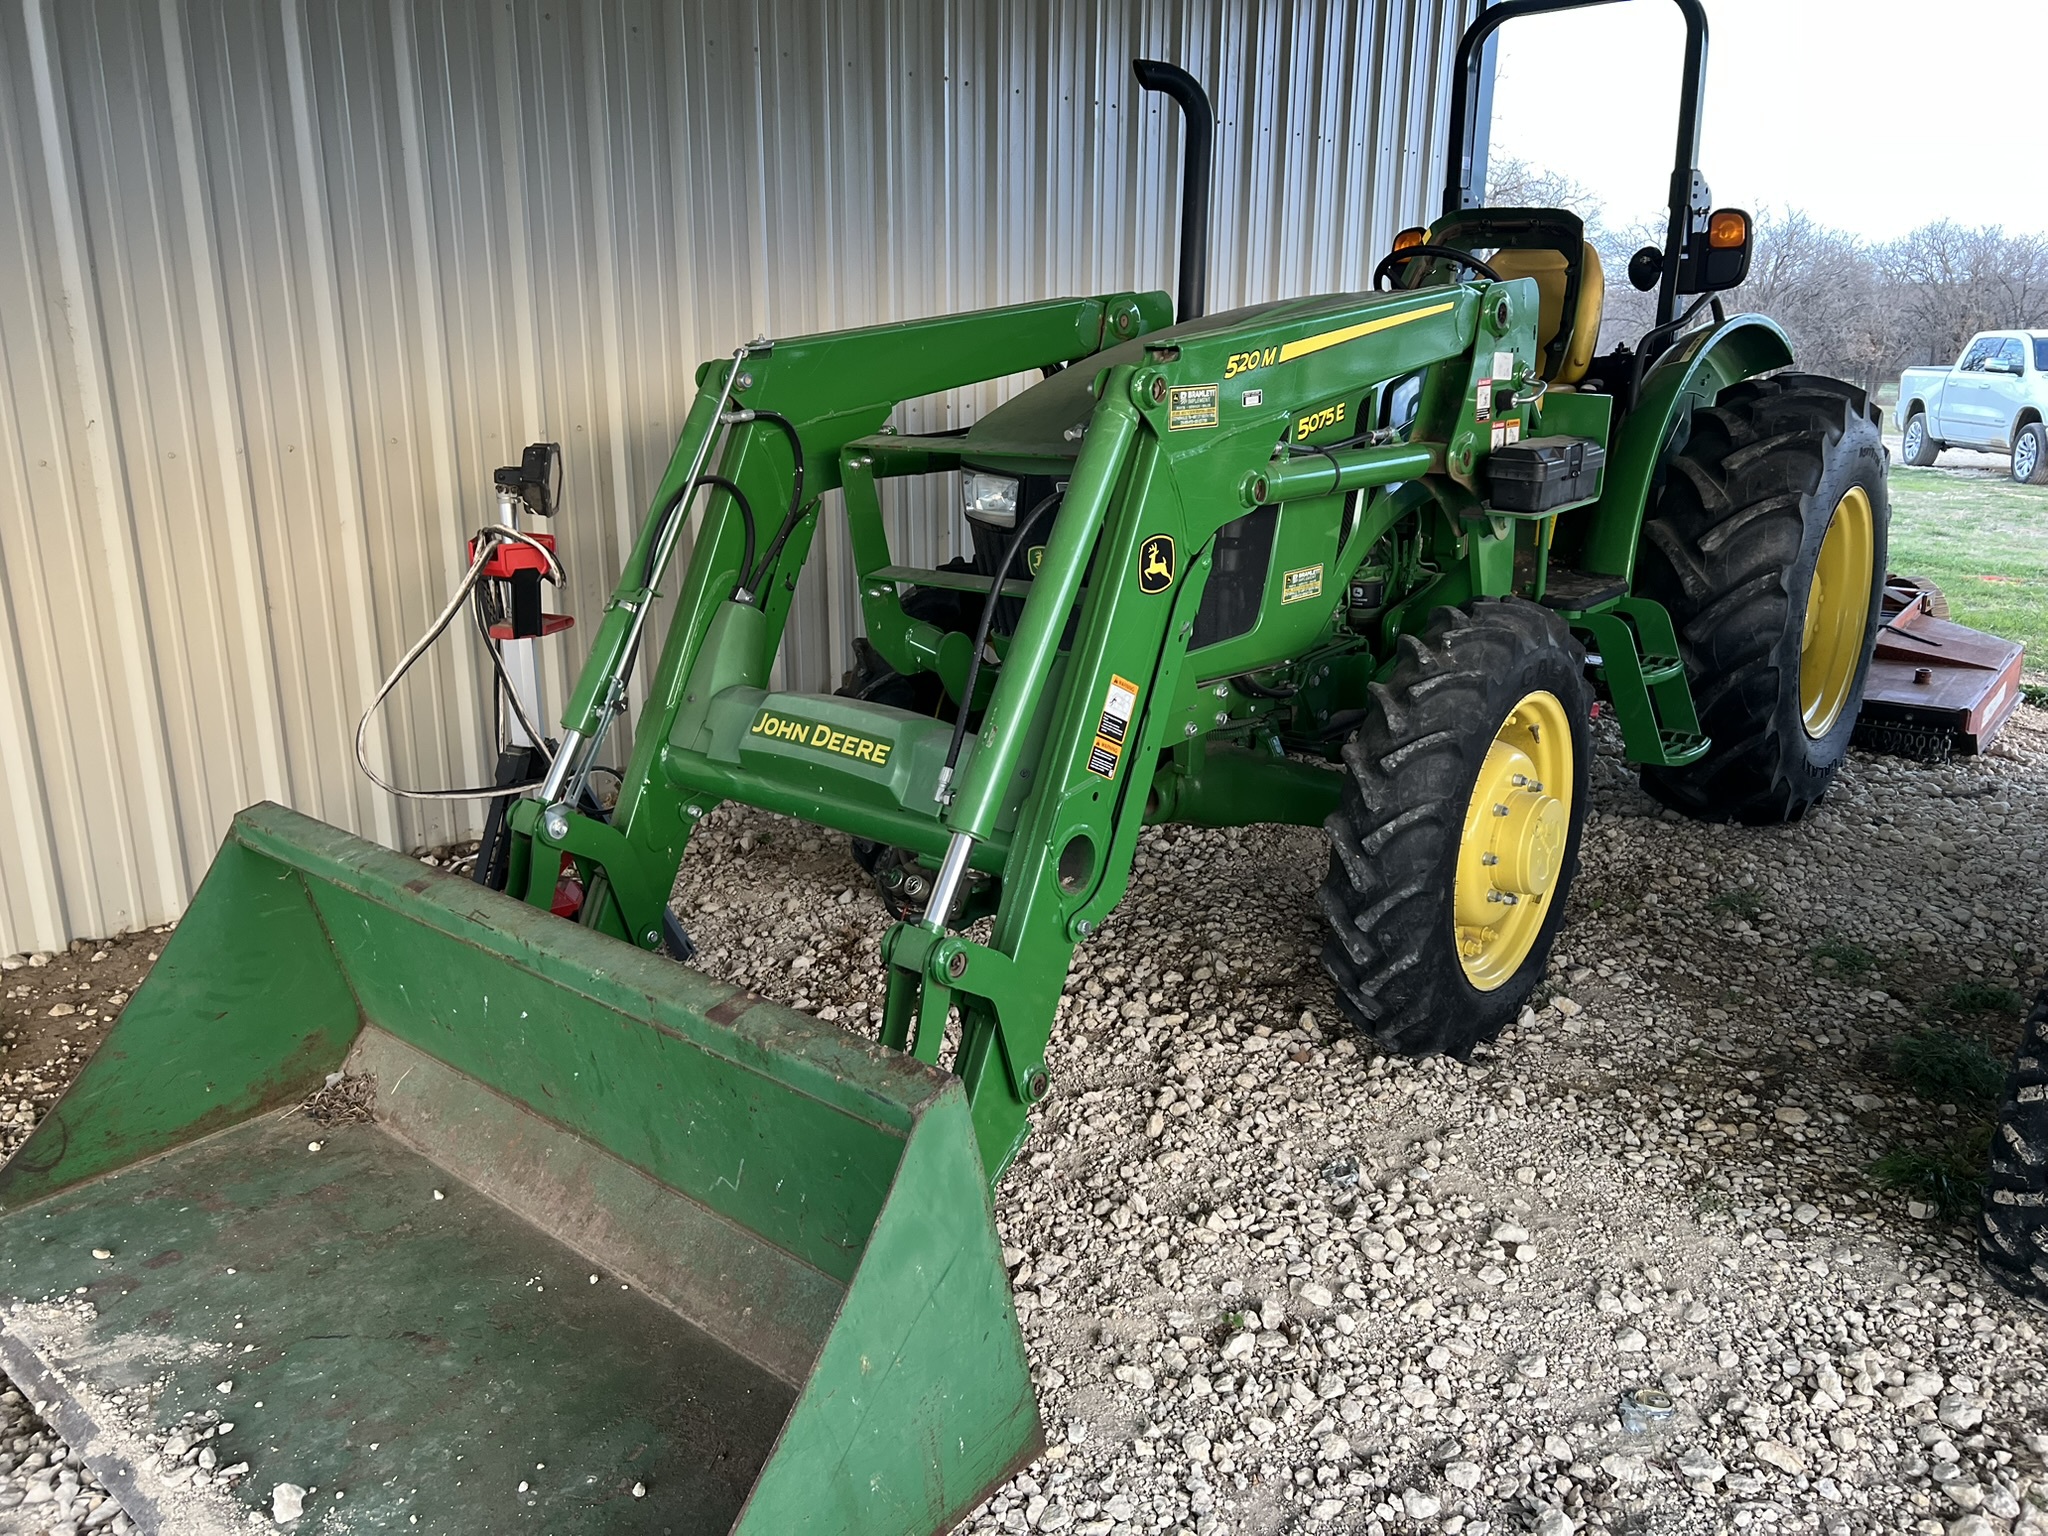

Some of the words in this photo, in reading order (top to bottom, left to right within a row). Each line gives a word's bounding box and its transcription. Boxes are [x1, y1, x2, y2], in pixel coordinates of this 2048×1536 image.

[1223, 350, 1260, 380] 520
[1260, 346, 1278, 368] M
[1297, 406, 1336, 441] 5075
[1335, 402, 1346, 423] E
[752, 712, 811, 743] JOHN
[810, 723, 891, 765] DEERE
